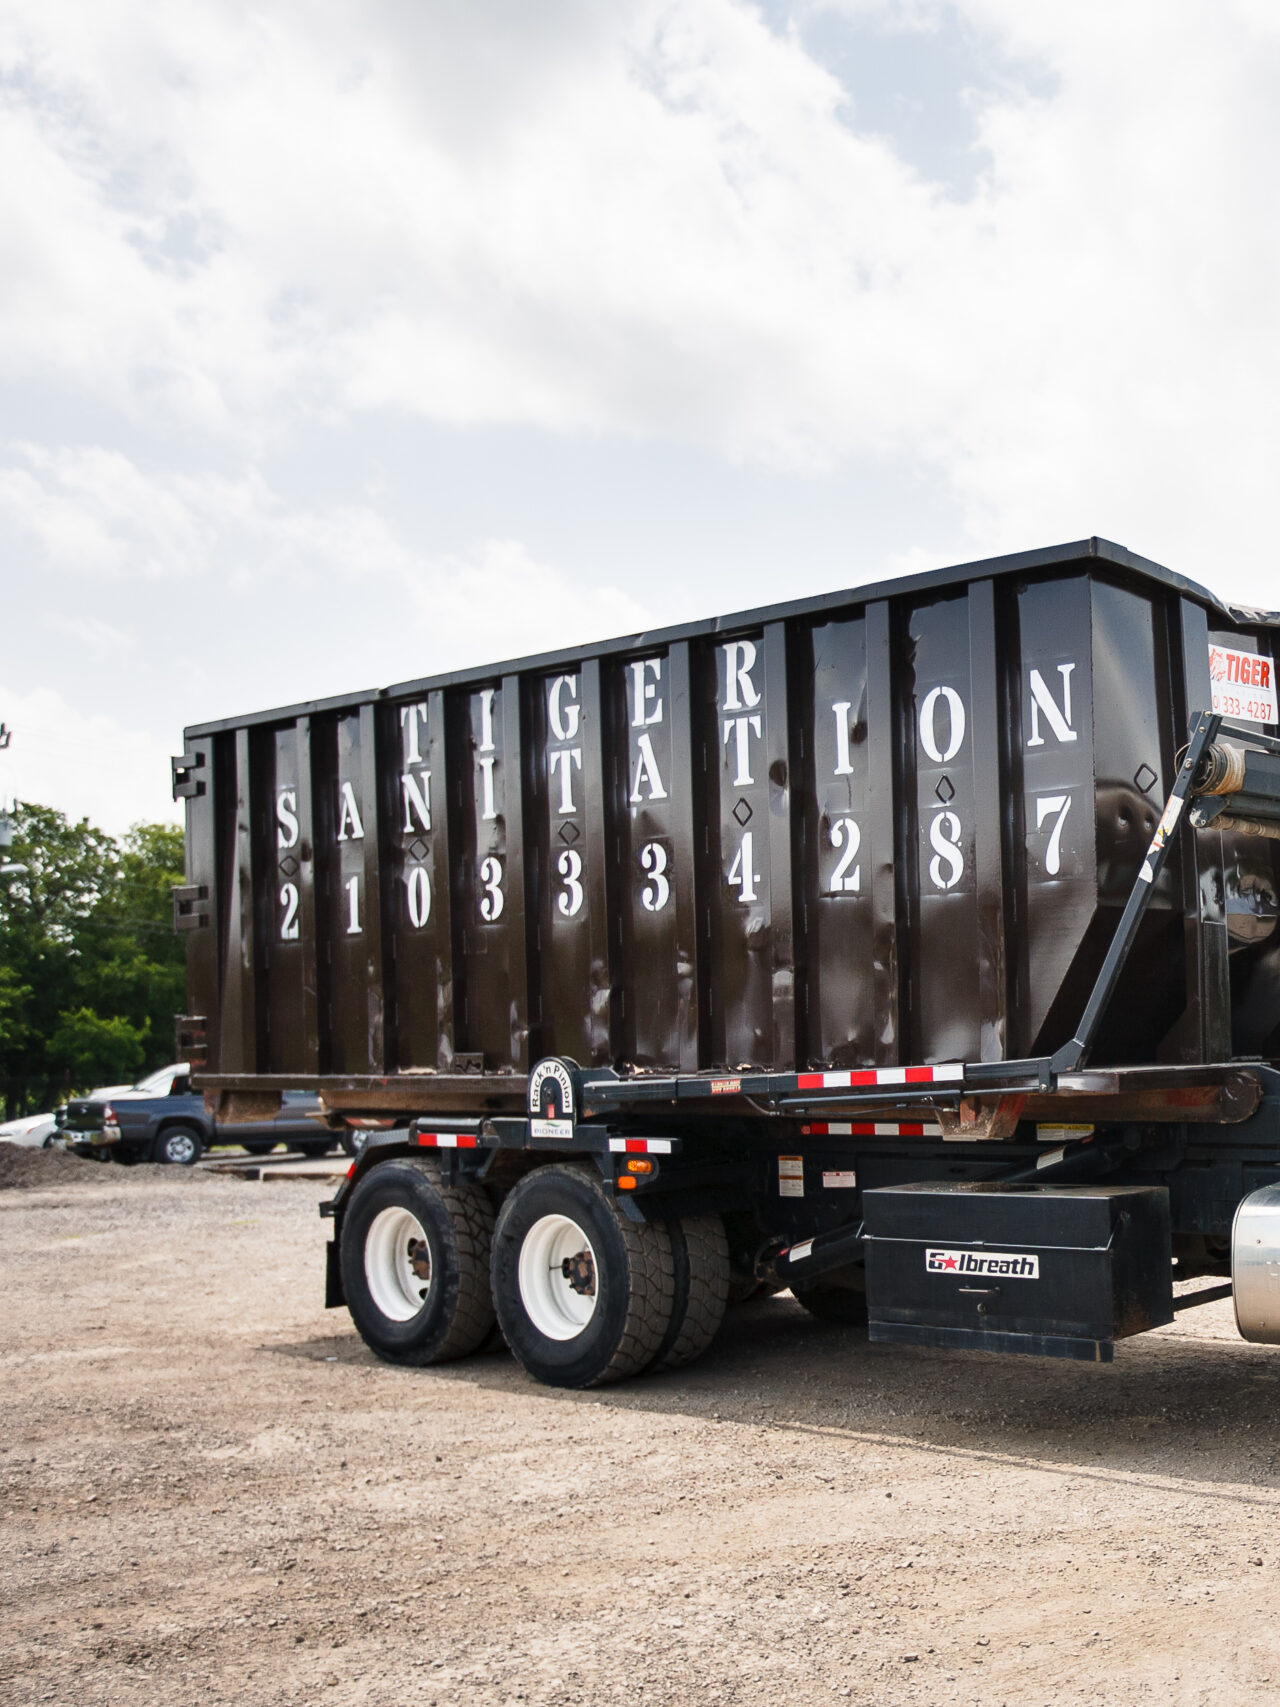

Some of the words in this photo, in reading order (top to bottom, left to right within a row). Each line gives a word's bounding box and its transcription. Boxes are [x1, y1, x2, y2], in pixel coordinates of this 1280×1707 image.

[401, 641, 762, 764] TIGER
[1223, 696, 1272, 720] 333-4287
[1226, 653, 1270, 689] TIGER
[276, 662, 1078, 849] SANITATION
